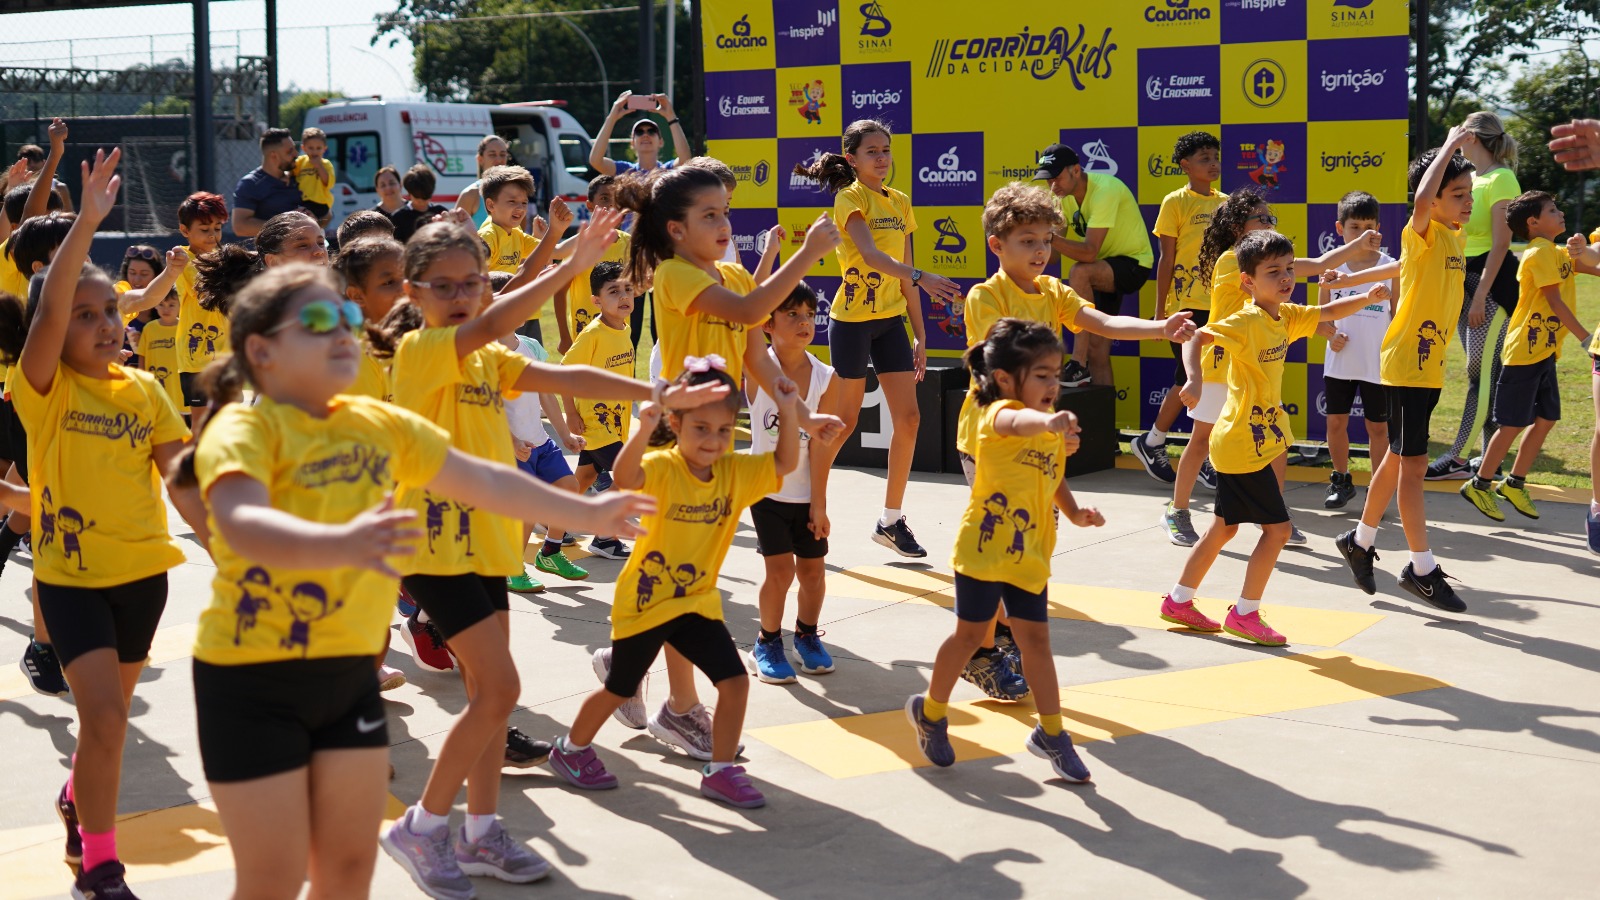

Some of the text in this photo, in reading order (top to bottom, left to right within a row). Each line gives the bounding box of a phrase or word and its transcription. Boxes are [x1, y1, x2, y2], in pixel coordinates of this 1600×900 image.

[1144, 5, 1211, 22] Cauana
[1331, 10, 1374, 21] SINAI
[790, 25, 825, 40] inspire
[716, 34, 768, 49] Cauana
[858, 39, 893, 48] SINAI
[950, 23, 1118, 91] CORRIDA Kids
[1169, 75, 1206, 86] EQUIPE
[919, 167, 977, 183] Cauana
[932, 255, 967, 264] SINAI
